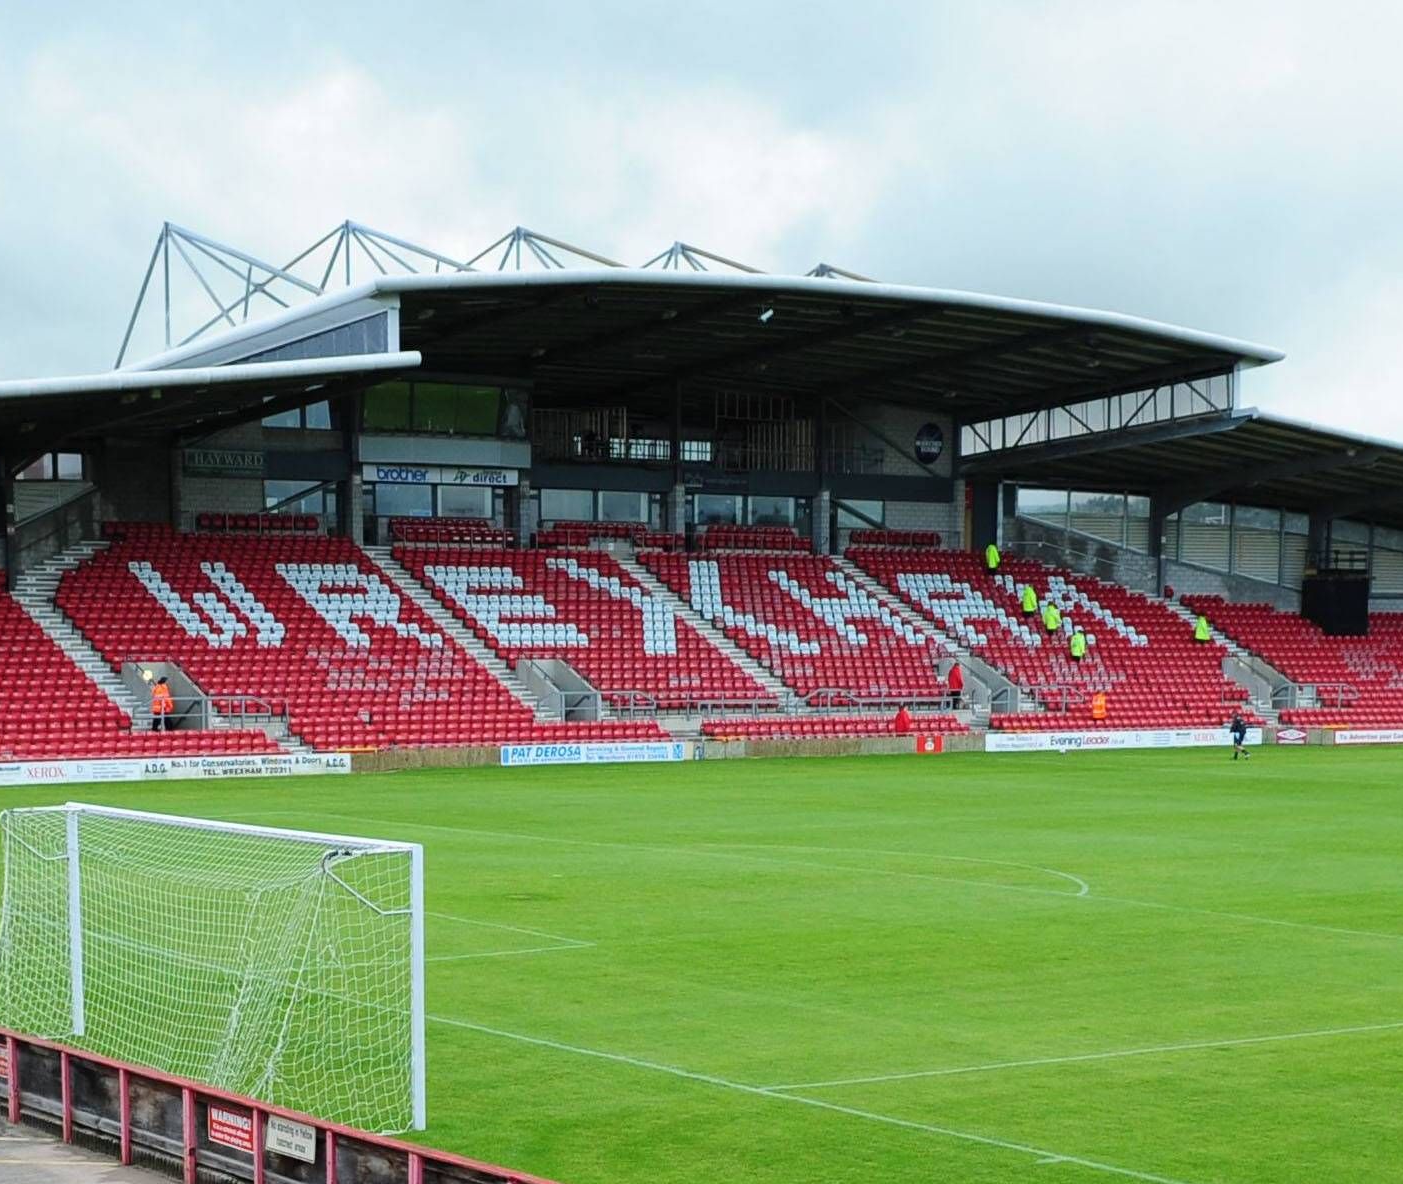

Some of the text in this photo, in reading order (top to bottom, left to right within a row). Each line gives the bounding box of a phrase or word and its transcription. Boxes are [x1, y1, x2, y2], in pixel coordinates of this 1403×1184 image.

[376, 465, 429, 481] brother
[511, 746, 581, 758] PAT DEROSA
